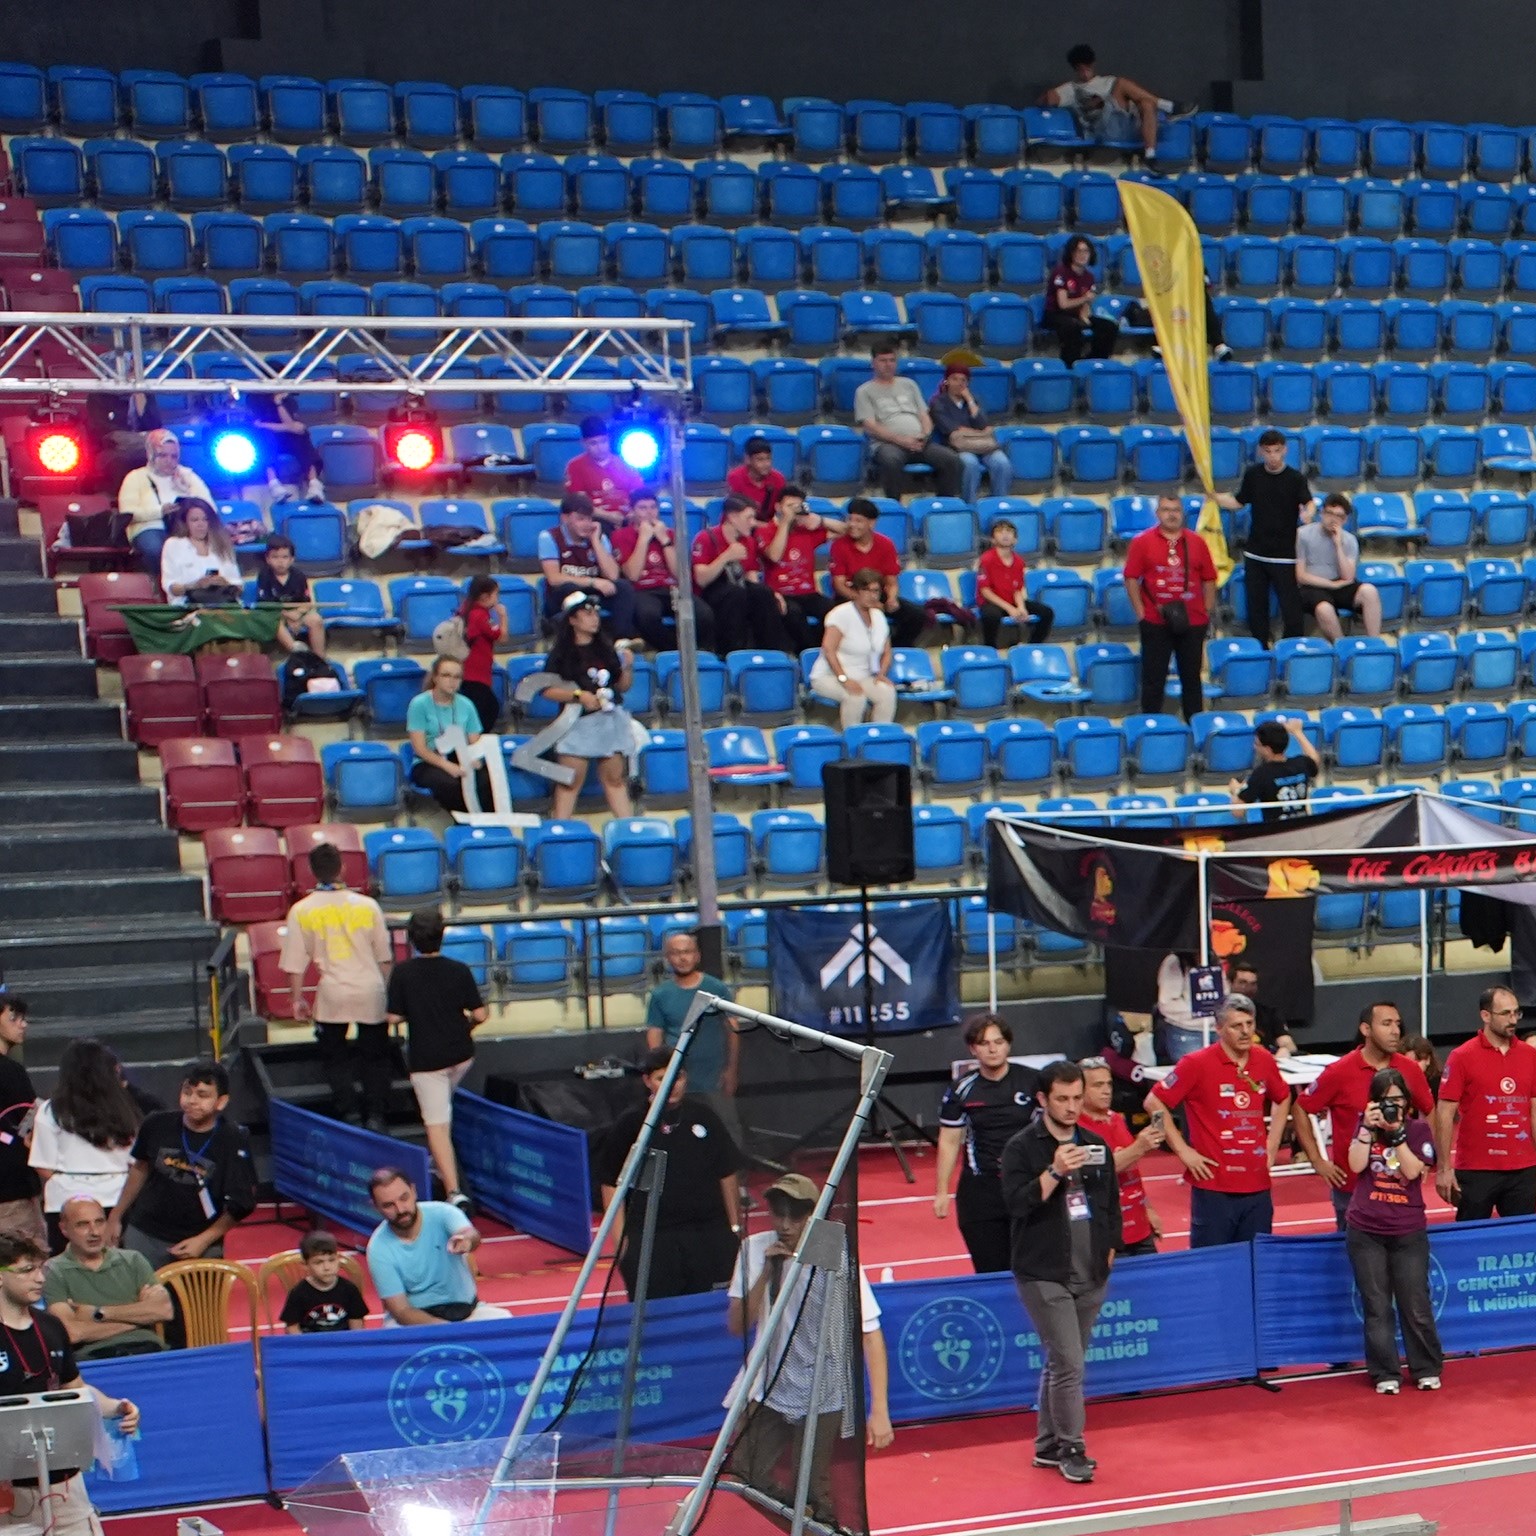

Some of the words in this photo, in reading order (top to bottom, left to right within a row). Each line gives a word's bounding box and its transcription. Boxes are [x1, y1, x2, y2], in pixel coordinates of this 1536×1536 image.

[1347, 857, 1392, 884] THE
[1457, 1272, 1521, 1294] GENÇLİK
[1467, 1295, 1481, 1313] İL
[1115, 1317, 1160, 1337] SPOR
